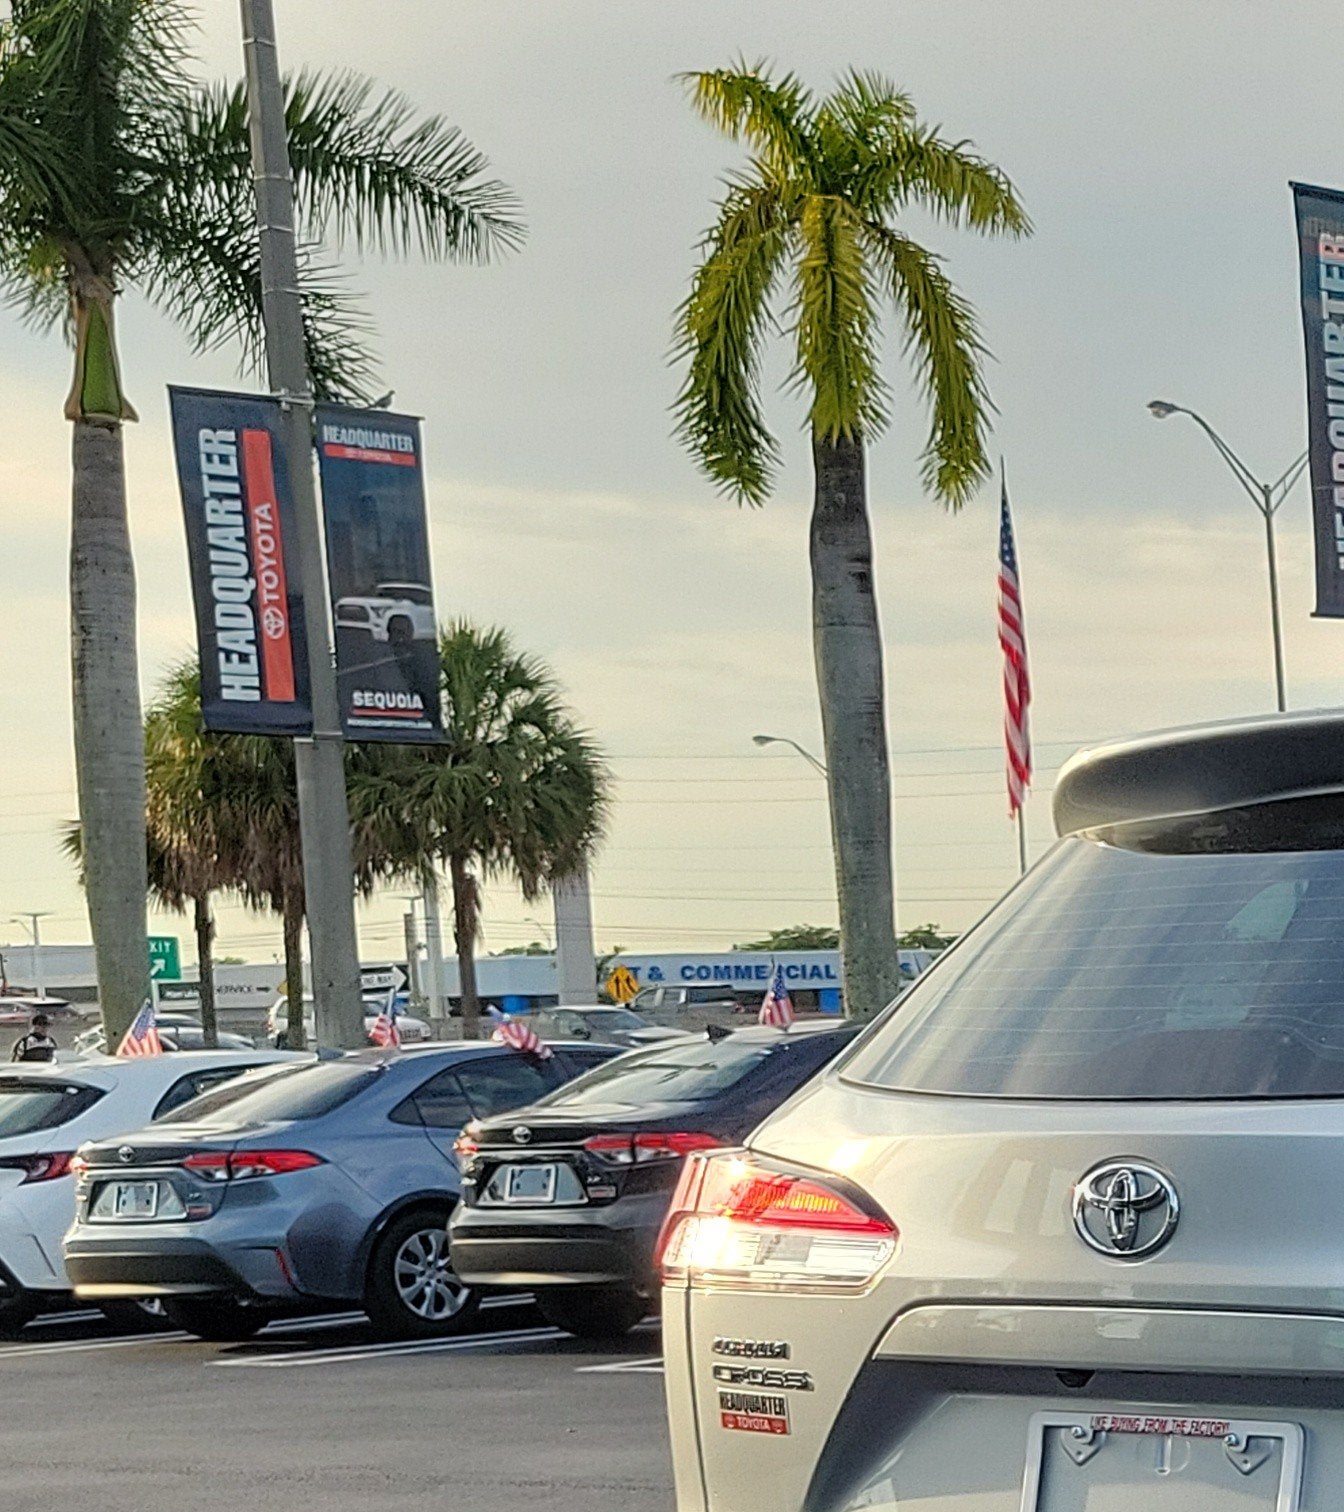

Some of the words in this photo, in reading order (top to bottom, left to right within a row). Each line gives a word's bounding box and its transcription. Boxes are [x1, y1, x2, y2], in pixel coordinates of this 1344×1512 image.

[322, 424, 415, 453] HEADQUARTER
[200, 427, 262, 702] HEADQUARTER
[253, 502, 281, 605] TOYOTA
[352, 689, 424, 710] SEQUOIA
[149, 940, 172, 953] XIT
[712, 1363, 815, 1391] CROSS
[719, 1390, 786, 1417] HEADQUARTER
[736, 1416, 771, 1431] TOYOTA
[1090, 1415, 1109, 1431] LIKE
[1144, 1418, 1169, 1434] FROM
[1172, 1419, 1187, 1434] THE
